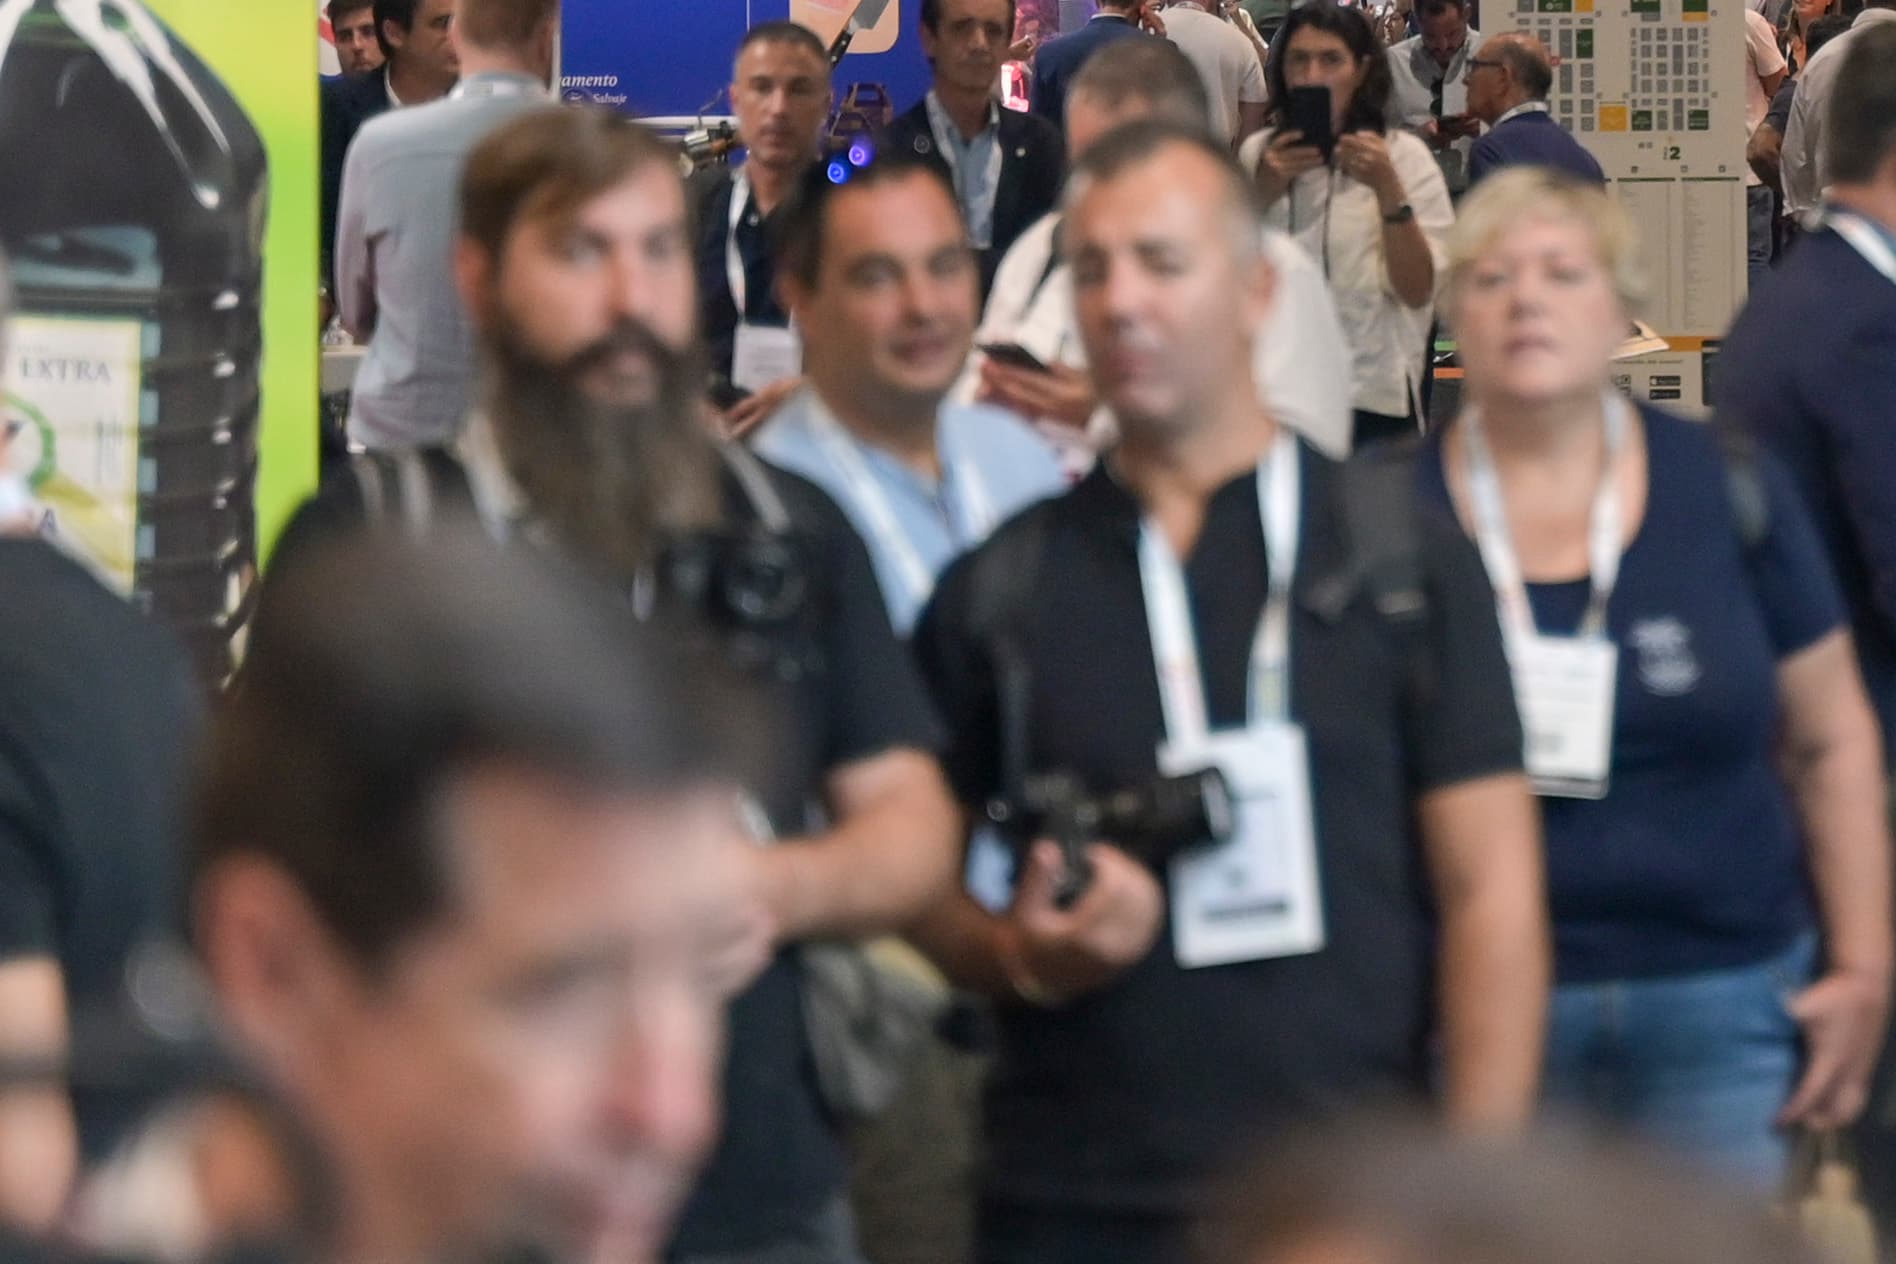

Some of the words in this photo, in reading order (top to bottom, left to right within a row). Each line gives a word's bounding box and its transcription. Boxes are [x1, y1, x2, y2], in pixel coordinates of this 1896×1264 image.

[558, 74, 618, 88] amento
[593, 92, 628, 105] Salvaje
[1669, 146, 1681, 160] 2
[20, 357, 112, 384] EXTRA
